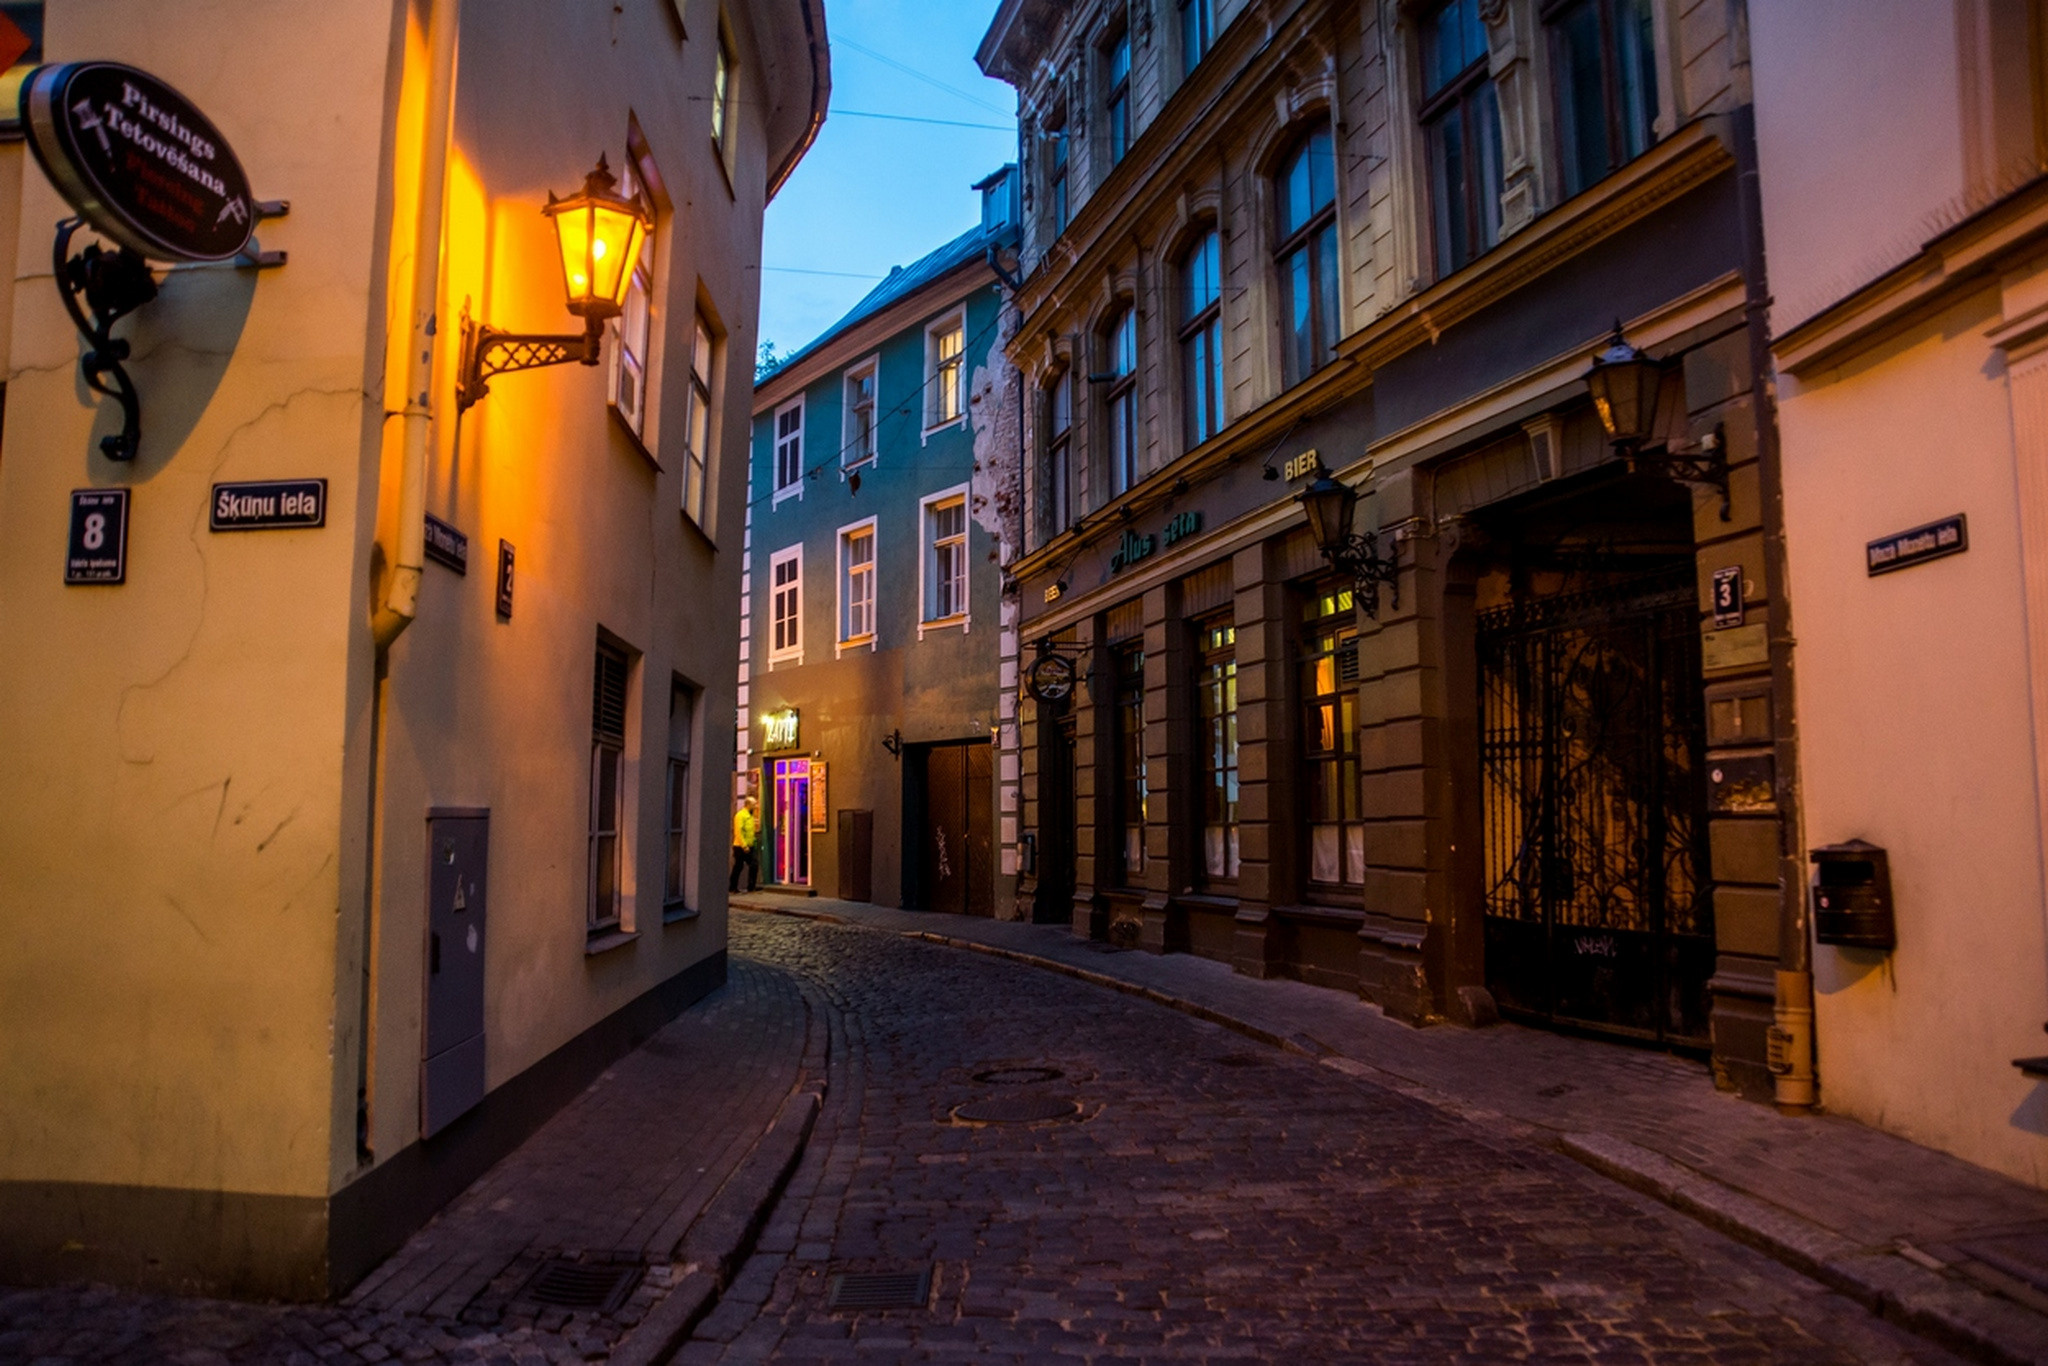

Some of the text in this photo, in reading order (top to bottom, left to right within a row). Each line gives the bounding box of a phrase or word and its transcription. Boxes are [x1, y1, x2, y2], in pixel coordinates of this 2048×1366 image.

[122, 81, 216, 160] Pirsings
[104, 102, 227, 197] Tetovēšana
[1284, 449, 1316, 482] BIER
[216, 491, 316, 521] Šķūņu iela
[83, 512, 105, 551] 8
[1719, 583, 1732, 607] 3
